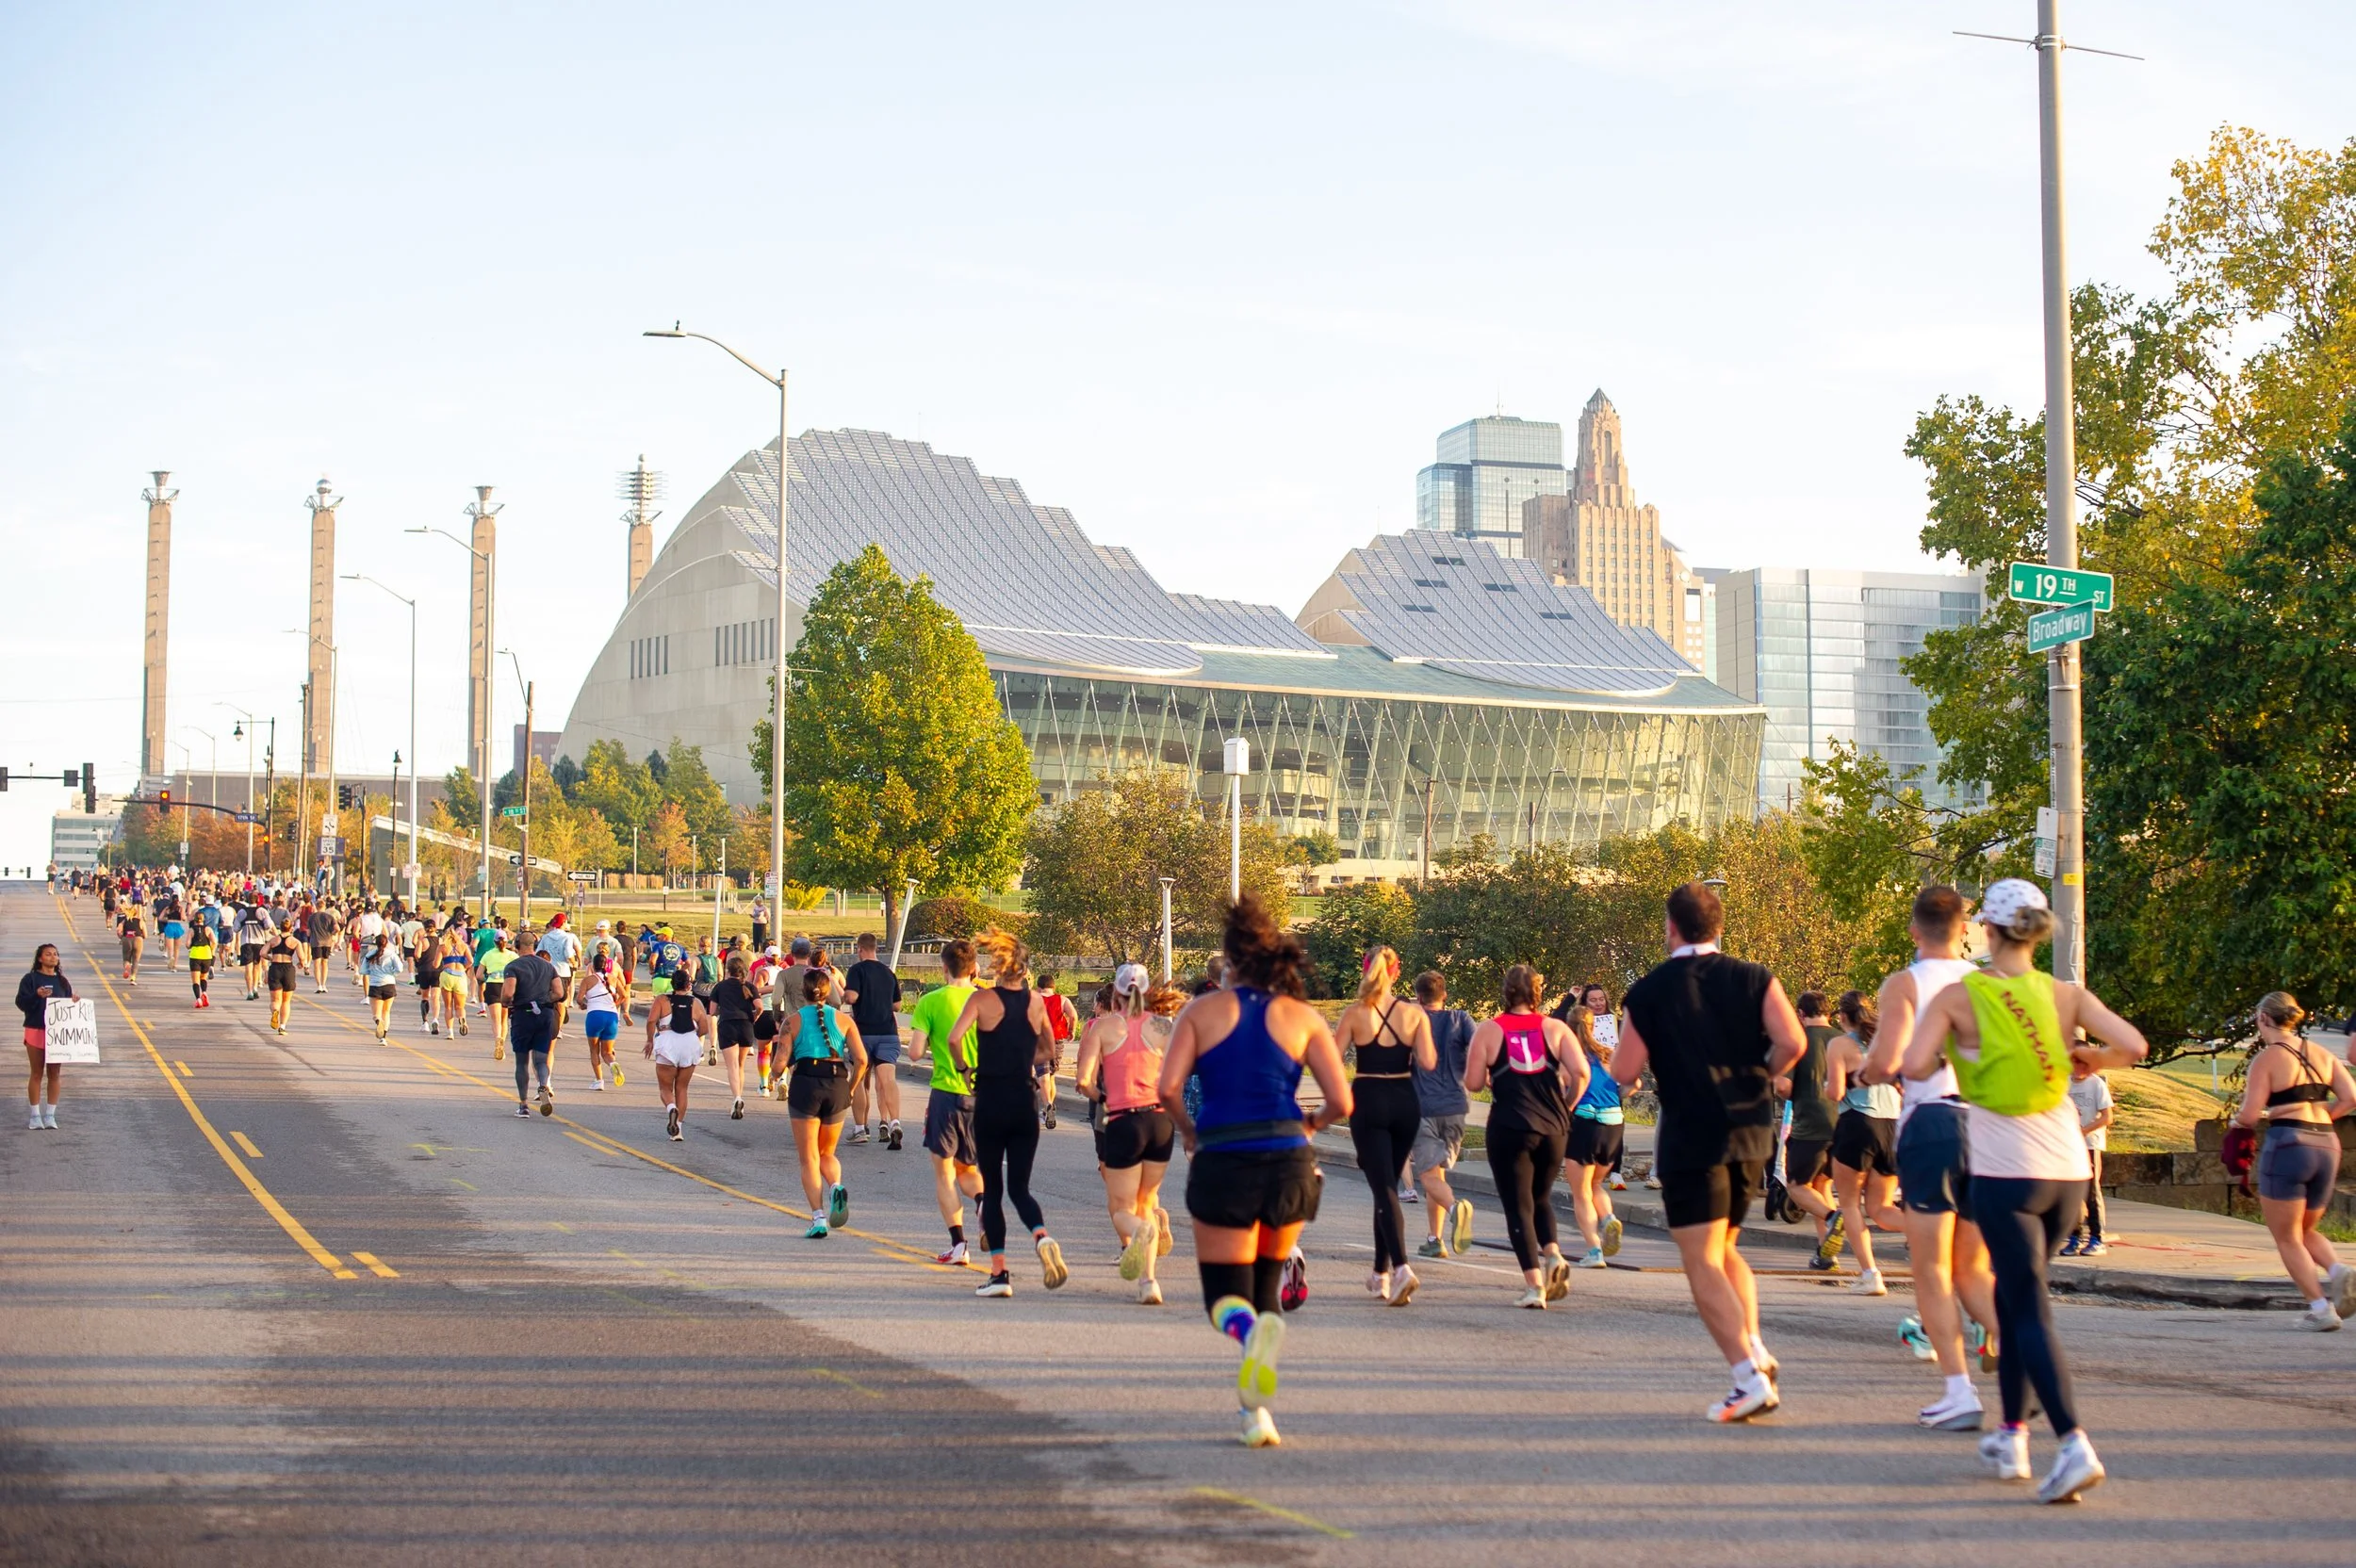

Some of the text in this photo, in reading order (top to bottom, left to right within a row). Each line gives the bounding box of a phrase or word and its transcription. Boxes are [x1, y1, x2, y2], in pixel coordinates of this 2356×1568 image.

[2014, 580, 2024, 593] W
[2093, 590, 2106, 604] ST
[2032, 612, 2087, 643] Broadway
[48, 1000, 75, 1026] JUST
[2000, 990, 2053, 1082] NATHAN
